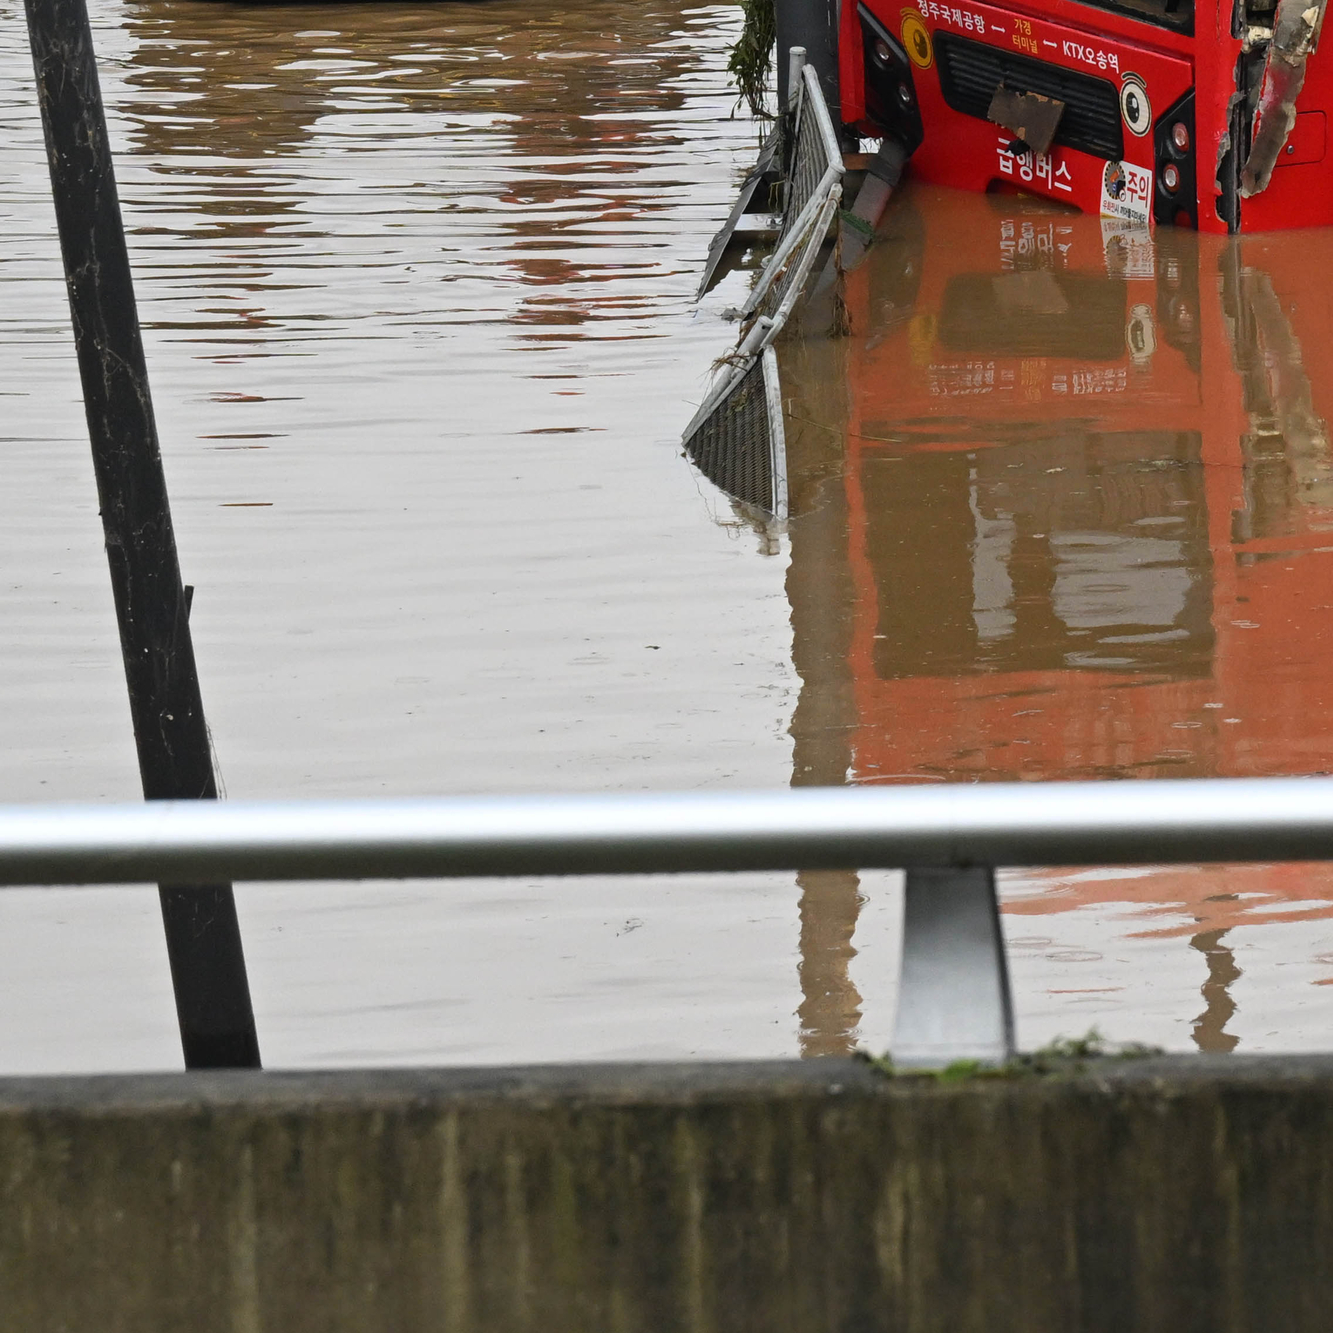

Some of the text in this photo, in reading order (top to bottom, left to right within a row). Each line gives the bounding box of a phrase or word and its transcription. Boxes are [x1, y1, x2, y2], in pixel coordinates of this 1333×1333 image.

[1012, 34, 1038, 54] 터미널
[1014, 18, 1032, 36] 가경
[1063, 40, 1119, 74] KTX오송역
[996, 137, 1072, 192] 급행버스
[1127, 170, 1150, 209] 주의
